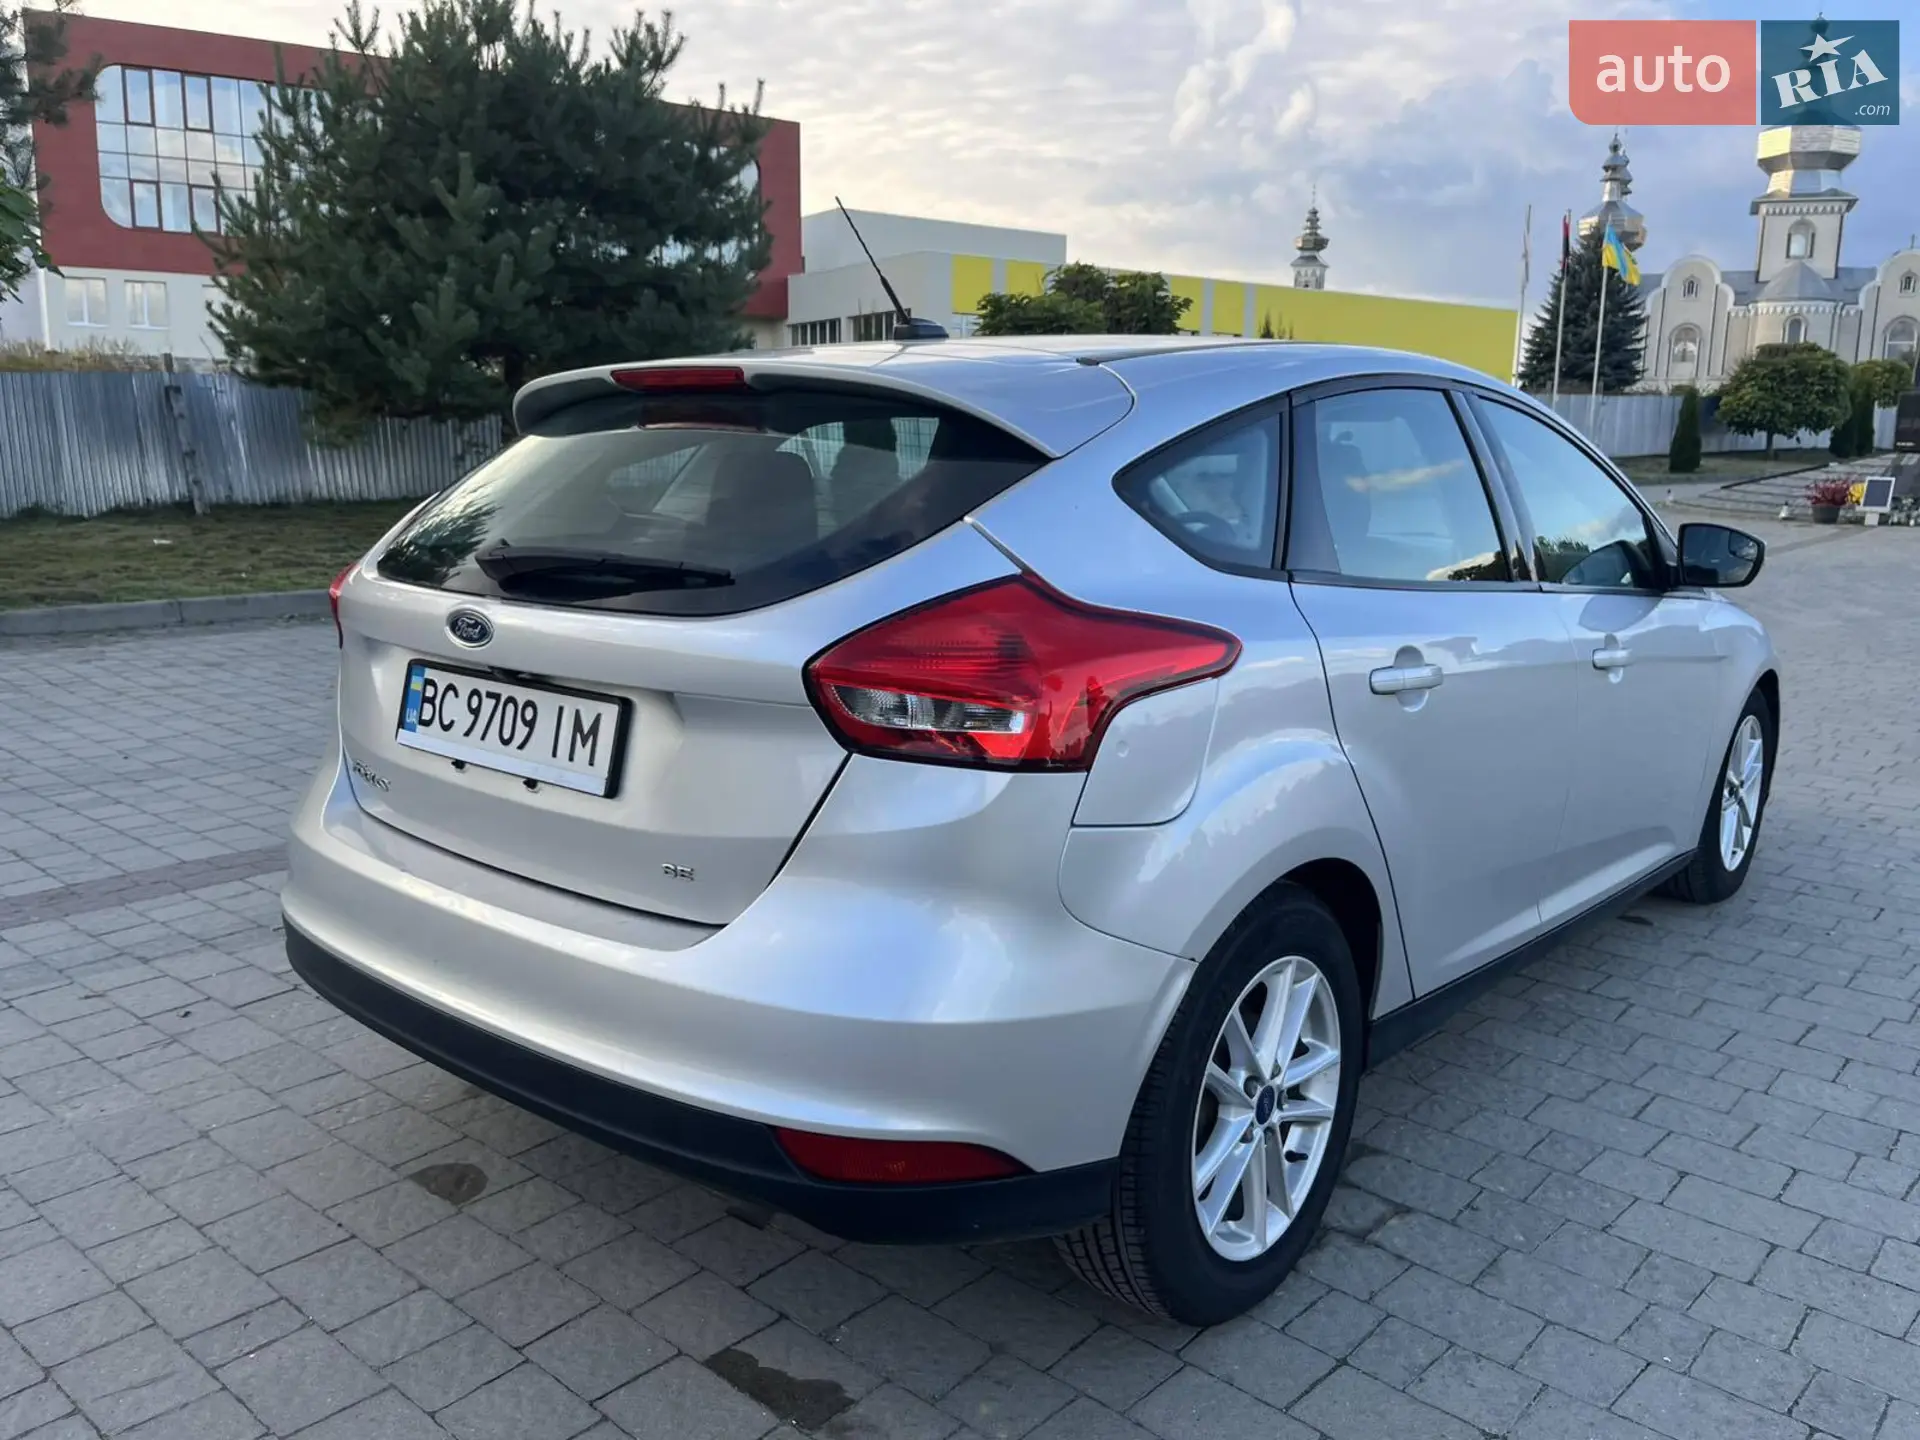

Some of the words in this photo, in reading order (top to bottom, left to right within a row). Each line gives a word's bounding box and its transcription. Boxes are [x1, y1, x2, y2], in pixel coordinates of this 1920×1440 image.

[455, 616, 482, 639] Ford
[418, 677, 460, 732] BC
[462, 687, 538, 751] 9709
[551, 705, 602, 768] IM
